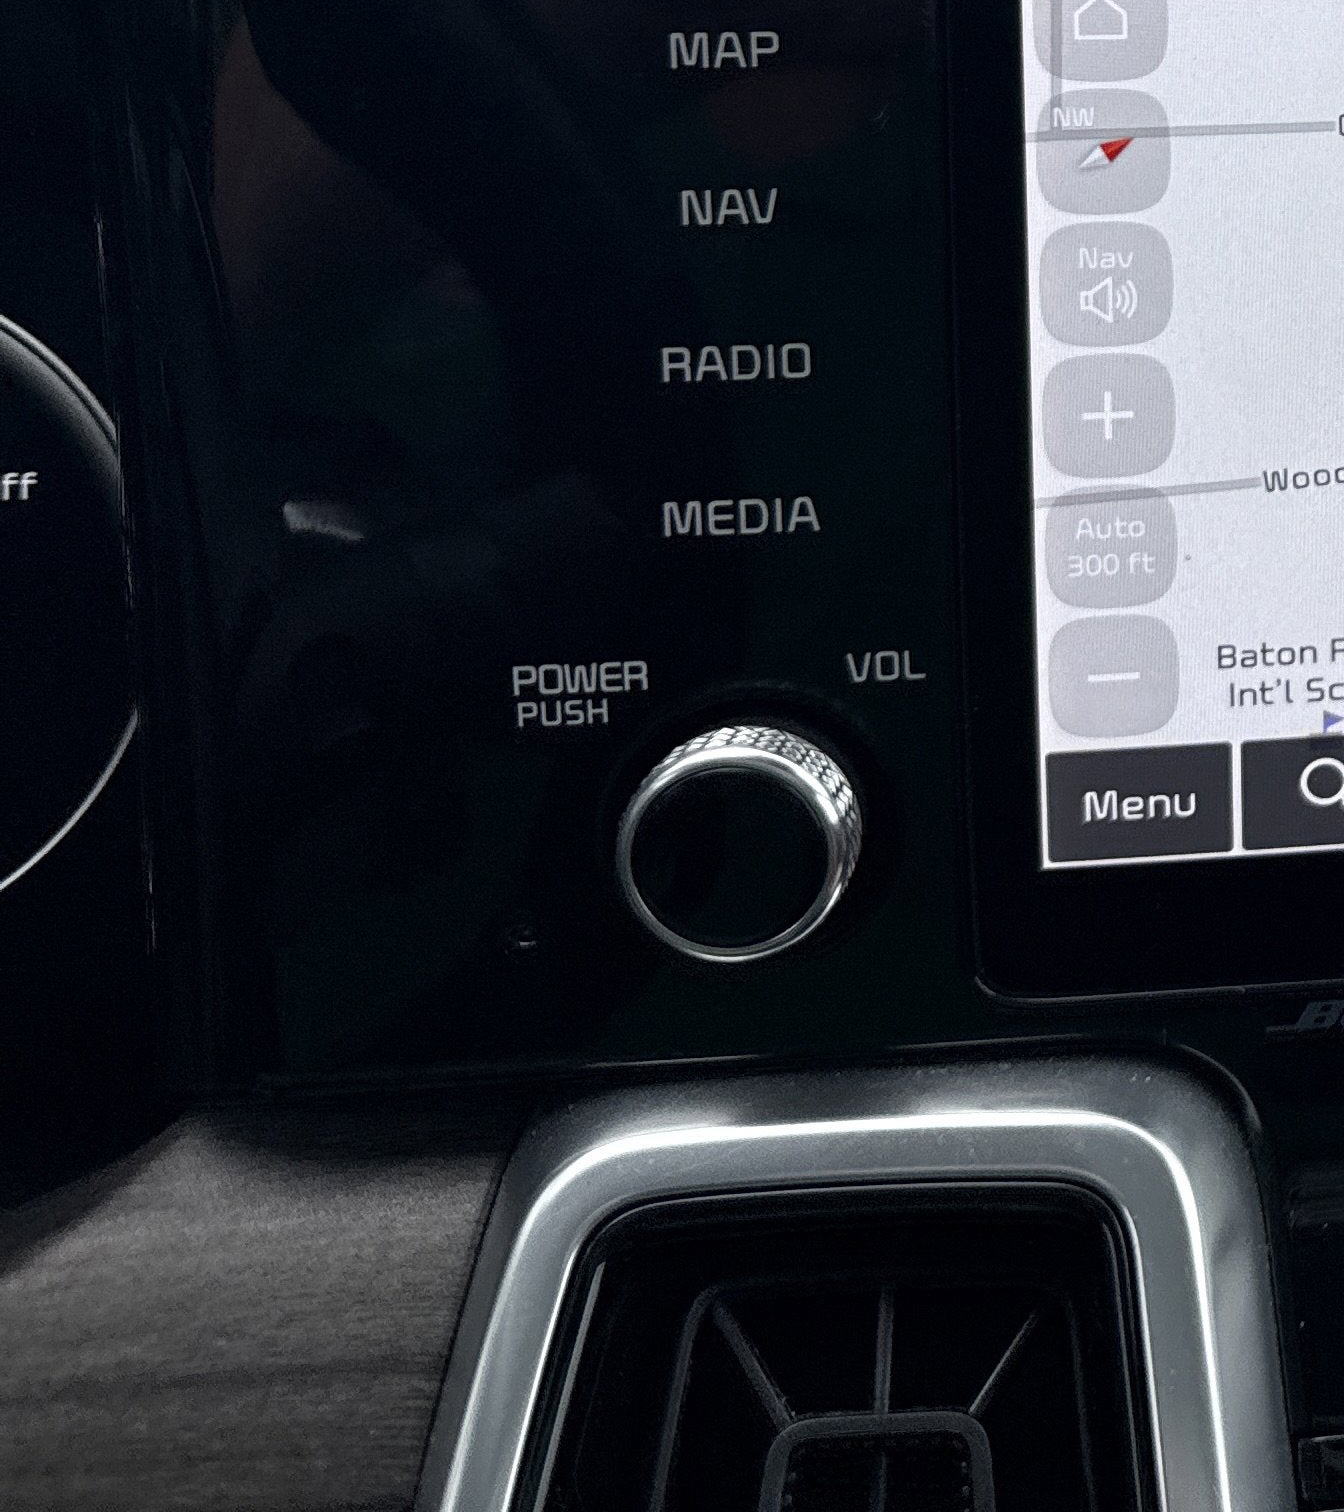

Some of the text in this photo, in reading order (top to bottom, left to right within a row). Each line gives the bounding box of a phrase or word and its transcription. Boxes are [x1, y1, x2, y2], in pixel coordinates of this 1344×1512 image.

[669, 31, 780, 69] MAP
[1052, 106, 1095, 129] NW
[680, 188, 779, 226] NAV
[1078, 248, 1134, 270] Nav
[660, 343, 813, 383] RADIO
[662, 496, 821, 538] MEDIA
[1076, 517, 1146, 540] Auto
[1068, 553, 1156, 577] 300 ft
[846, 649, 926, 684] VOL
[1217, 643, 1318, 670] Baton
[512, 660, 649, 695] POWER
[1229, 678, 1293, 707] Int'l
[517, 698, 609, 727] PUSH
[1082, 790, 1197, 822] Menu
